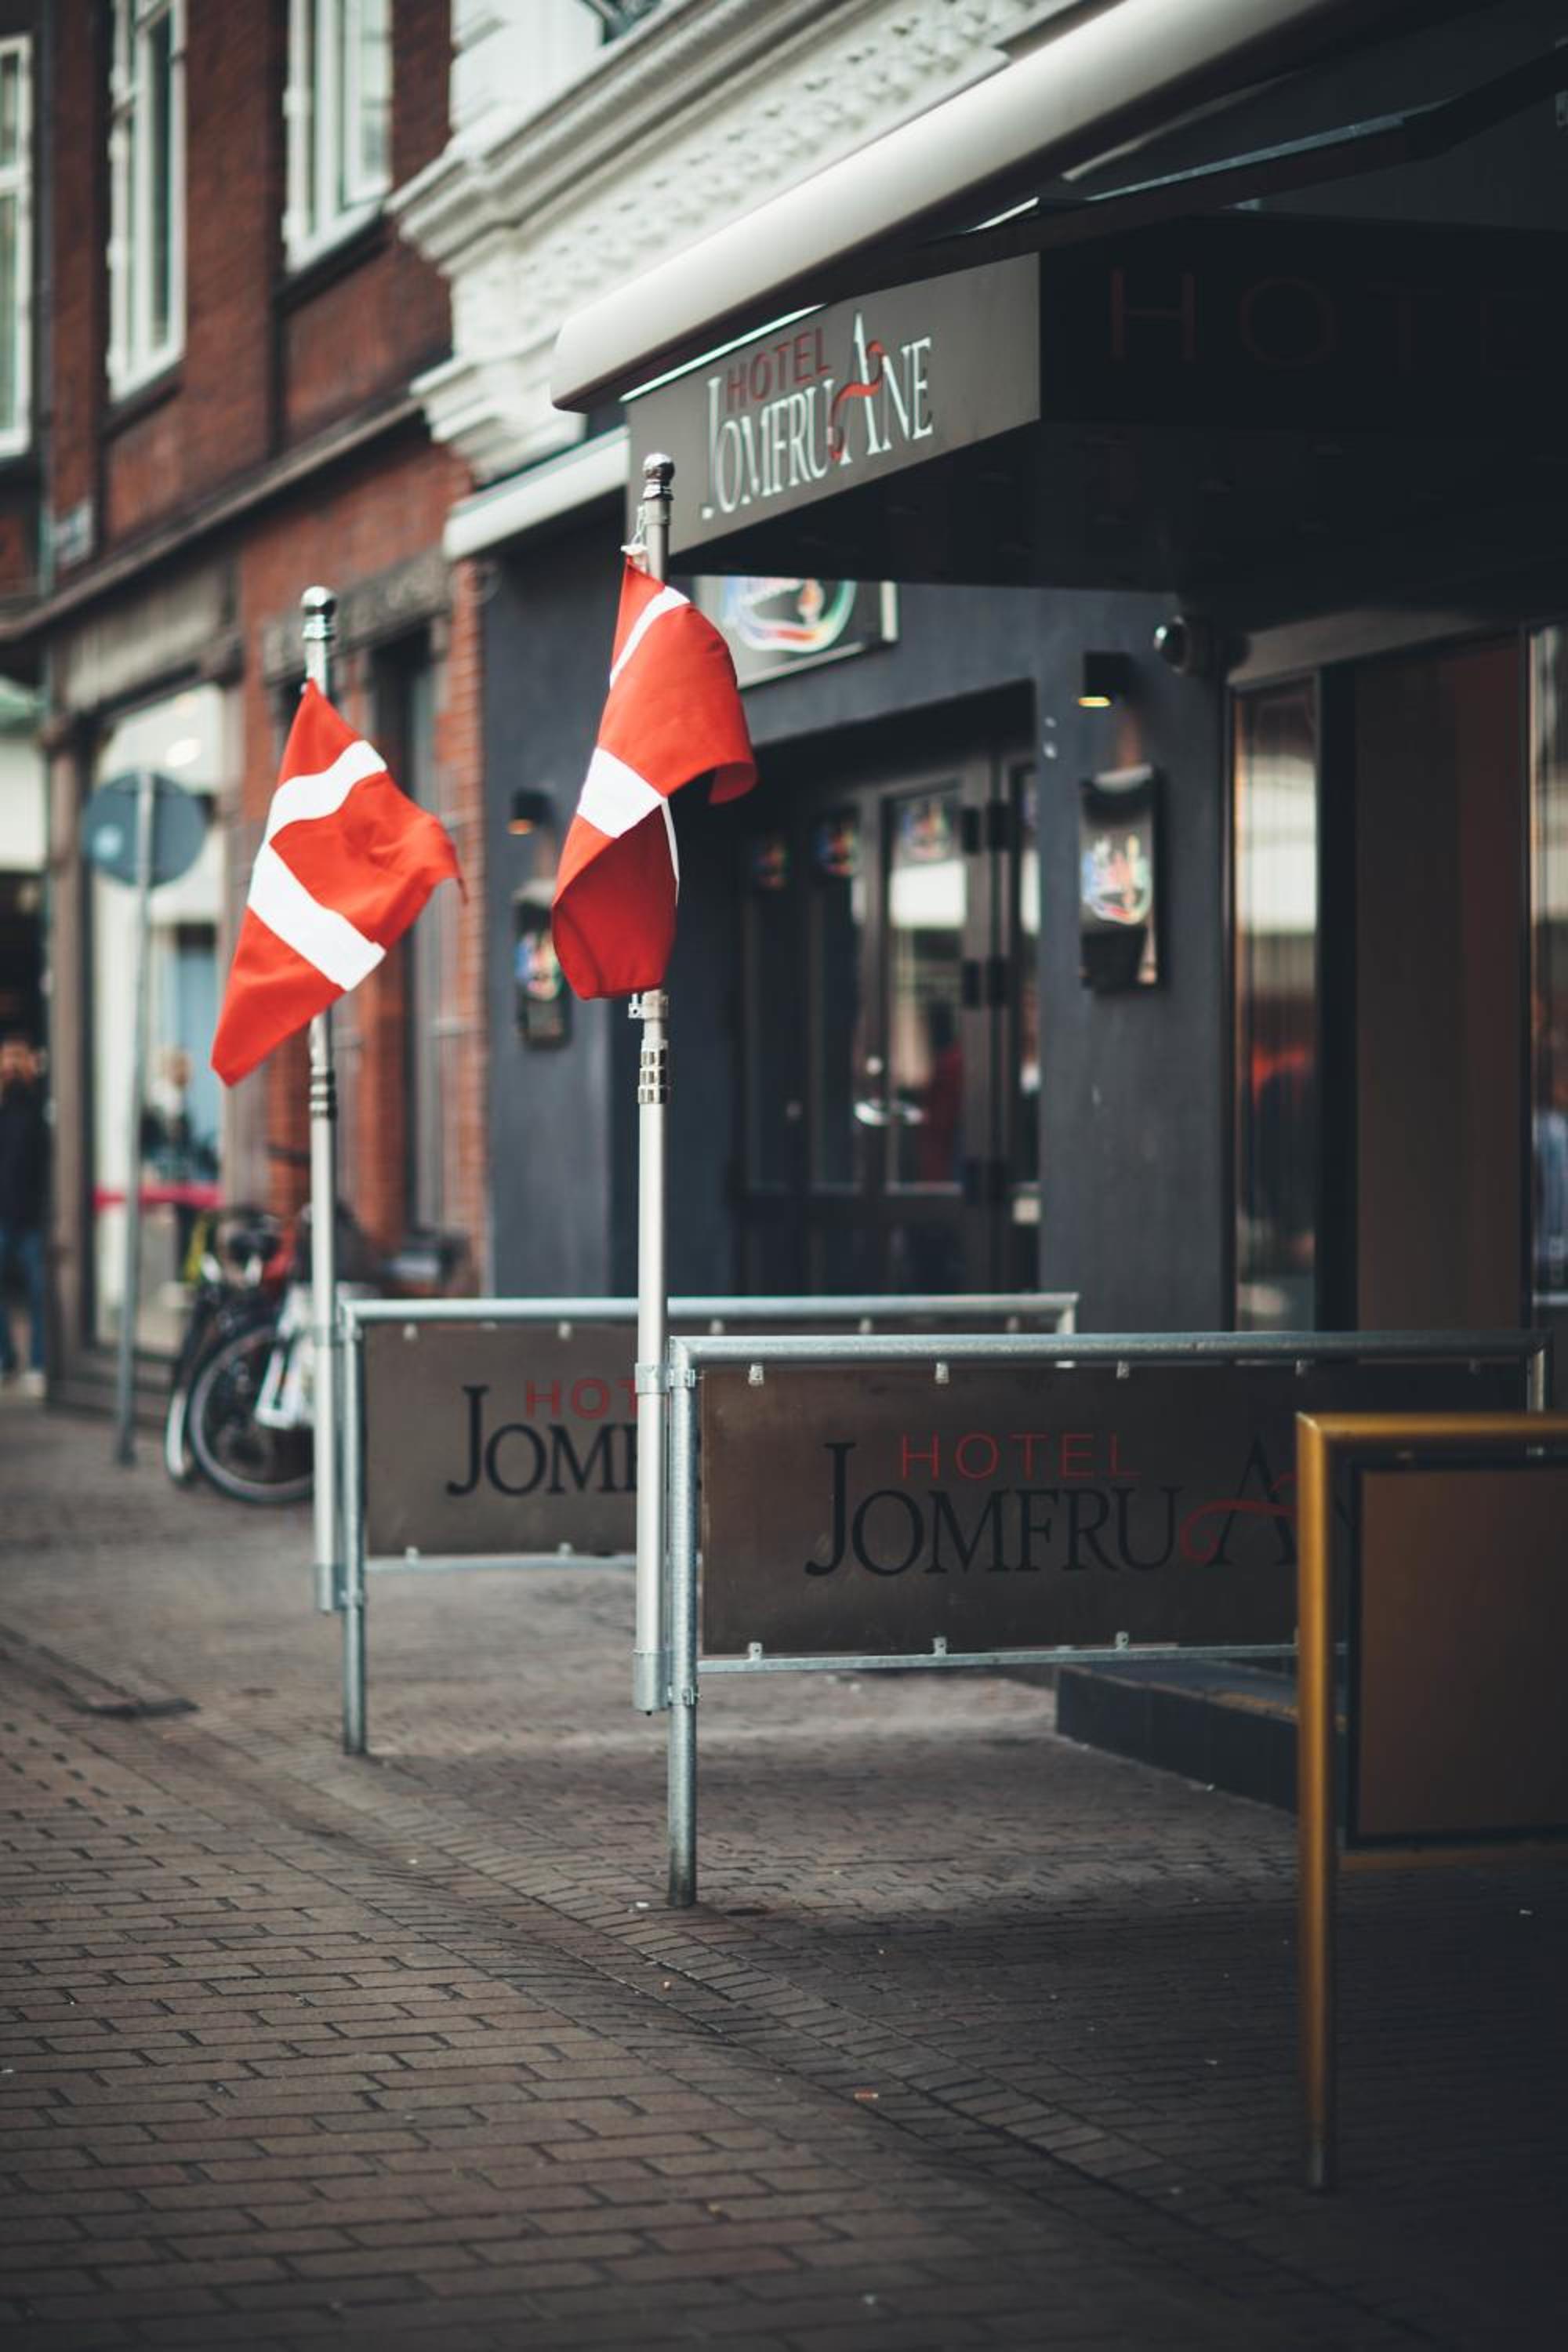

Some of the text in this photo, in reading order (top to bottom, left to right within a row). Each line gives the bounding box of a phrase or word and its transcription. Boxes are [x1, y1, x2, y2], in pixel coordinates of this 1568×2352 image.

[702, 313, 934, 520] JOMFRU ANE
[727, 326, 832, 413] HOTEL
[446, 1385, 638, 1497] JOM
[525, 1377, 638, 1419] HOT
[901, 1432, 1142, 1481] HOTEL
[804, 1441, 1185, 1577] JOMFRU
